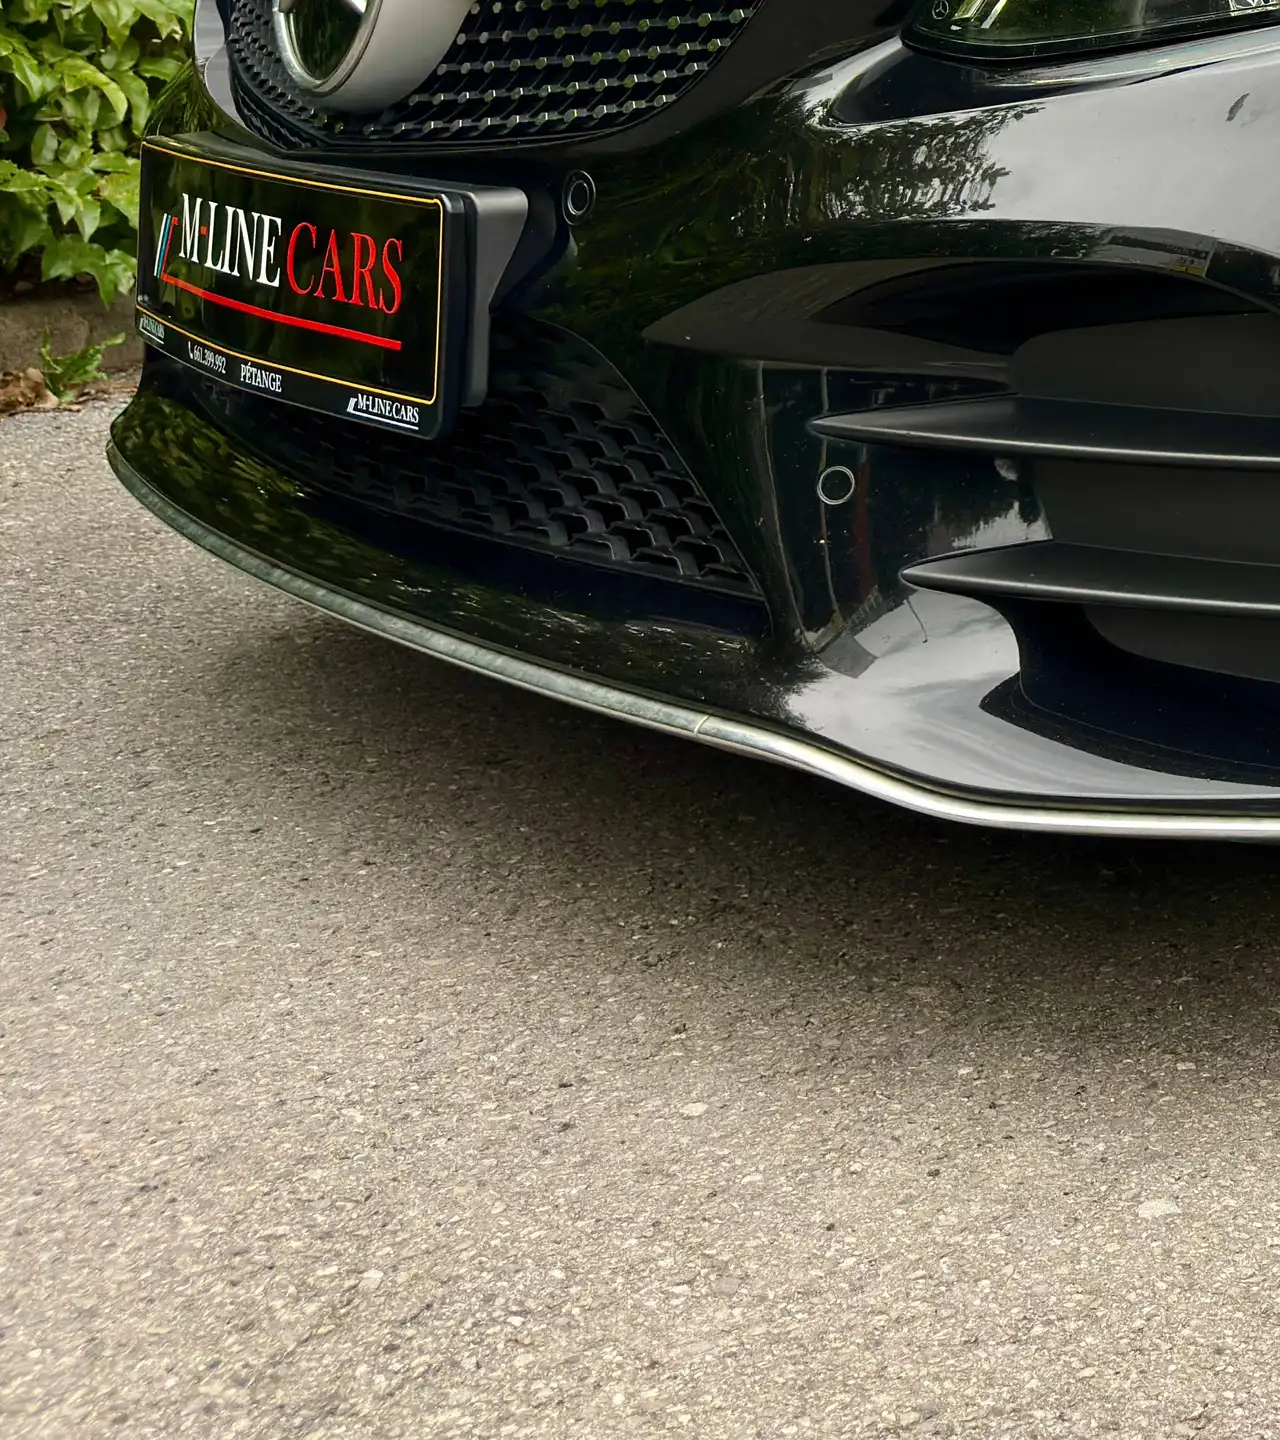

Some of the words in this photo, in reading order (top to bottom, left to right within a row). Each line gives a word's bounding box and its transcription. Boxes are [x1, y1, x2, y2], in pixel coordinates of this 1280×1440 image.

[178, 192, 283, 289] M-LINE
[286, 221, 403, 316] CARS
[240, 361, 282, 394] PÉTANGE
[357, 393, 393, 417] M-LINE
[392, 402, 419, 423] CARS
